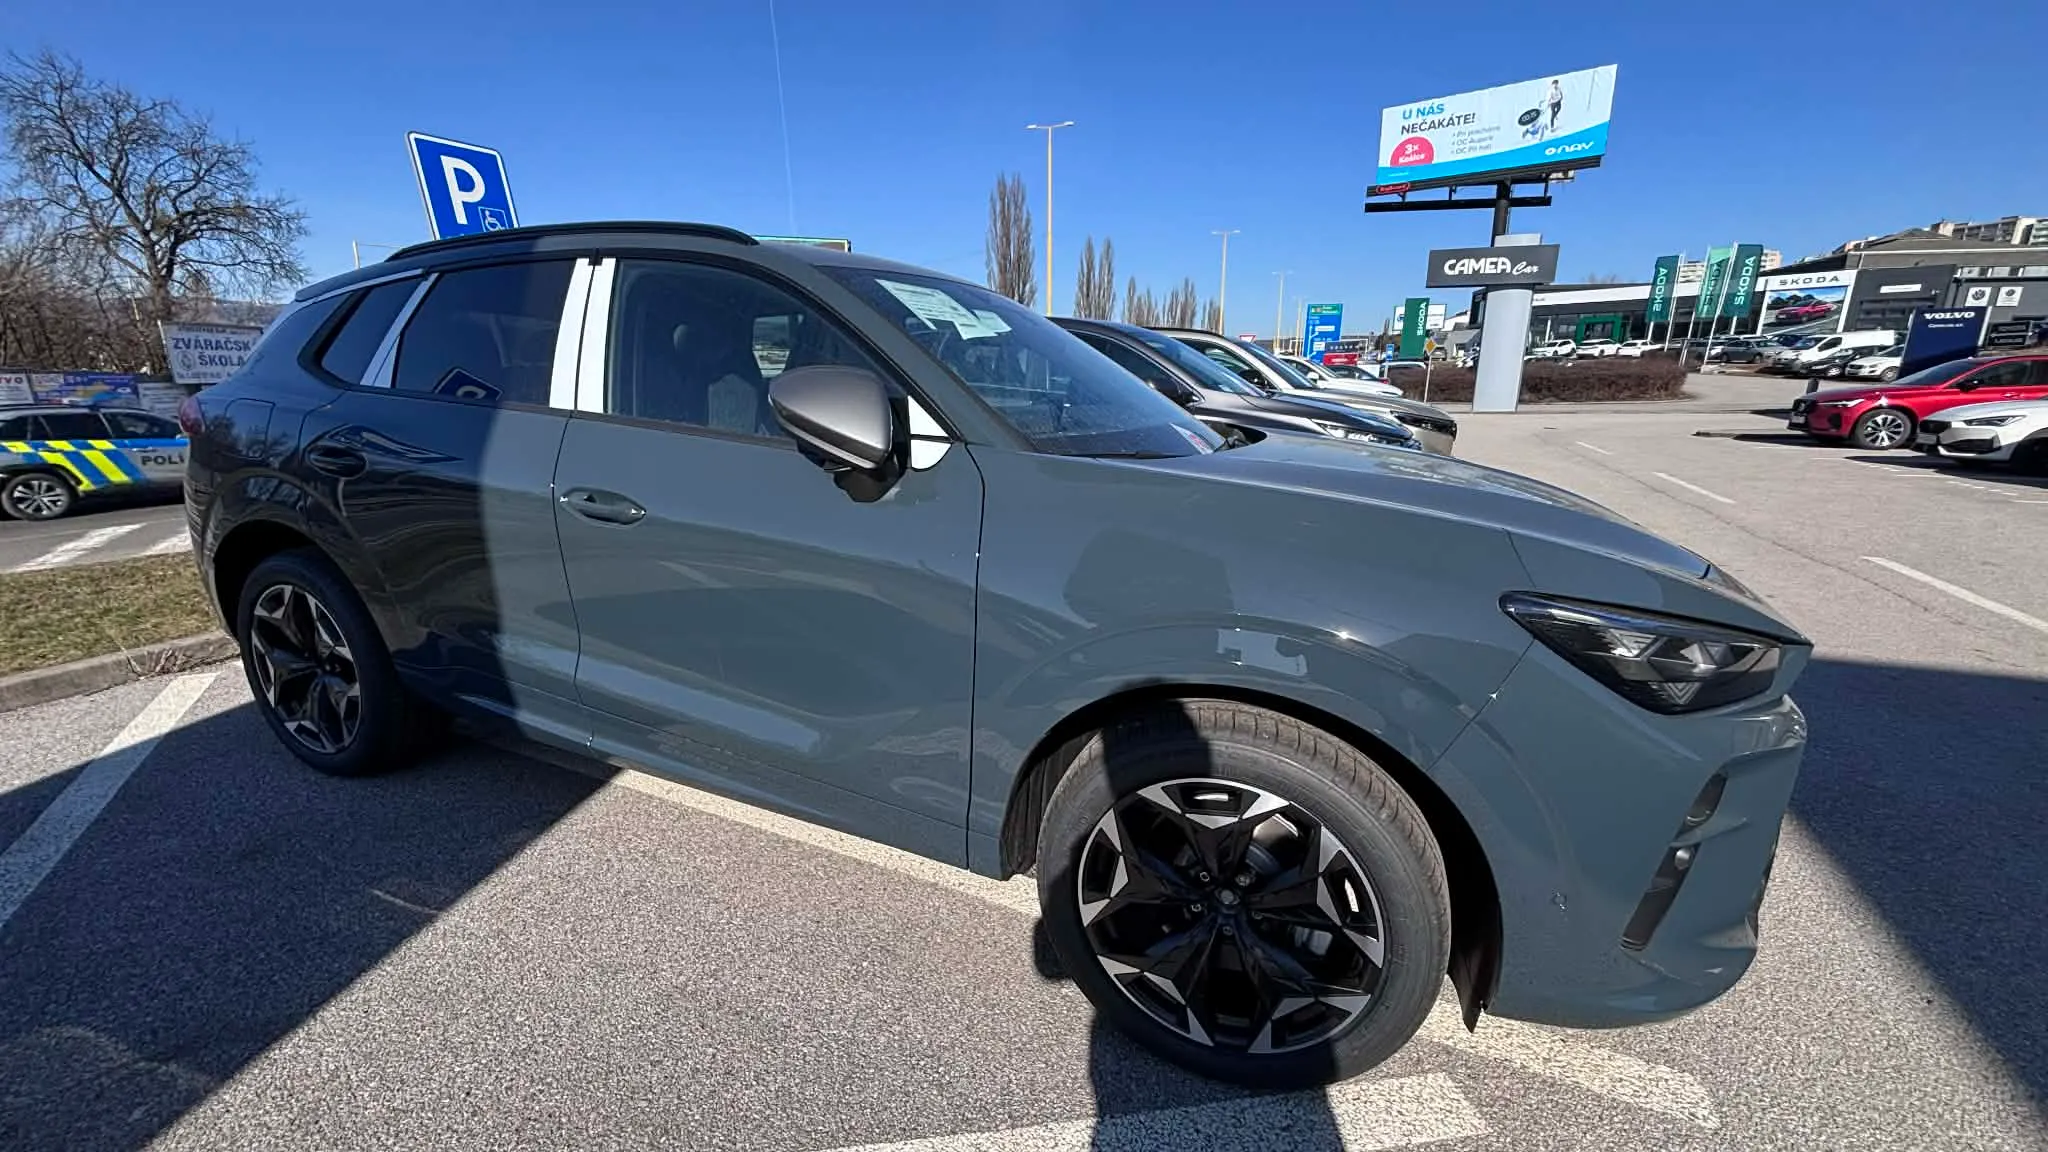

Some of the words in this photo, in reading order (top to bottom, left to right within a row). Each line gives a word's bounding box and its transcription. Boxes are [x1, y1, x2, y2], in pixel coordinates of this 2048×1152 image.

[1402, 110, 1412, 120] U
[1416, 103, 1445, 118] NÁS
[1401, 112, 1476, 136] NEČAKÁTE!
[440, 154, 486, 225] P
[1443, 256, 1512, 276] CAMEA
[1512, 261, 1539, 276] Car
[1923, 311, 1976, 321] VOLVO
